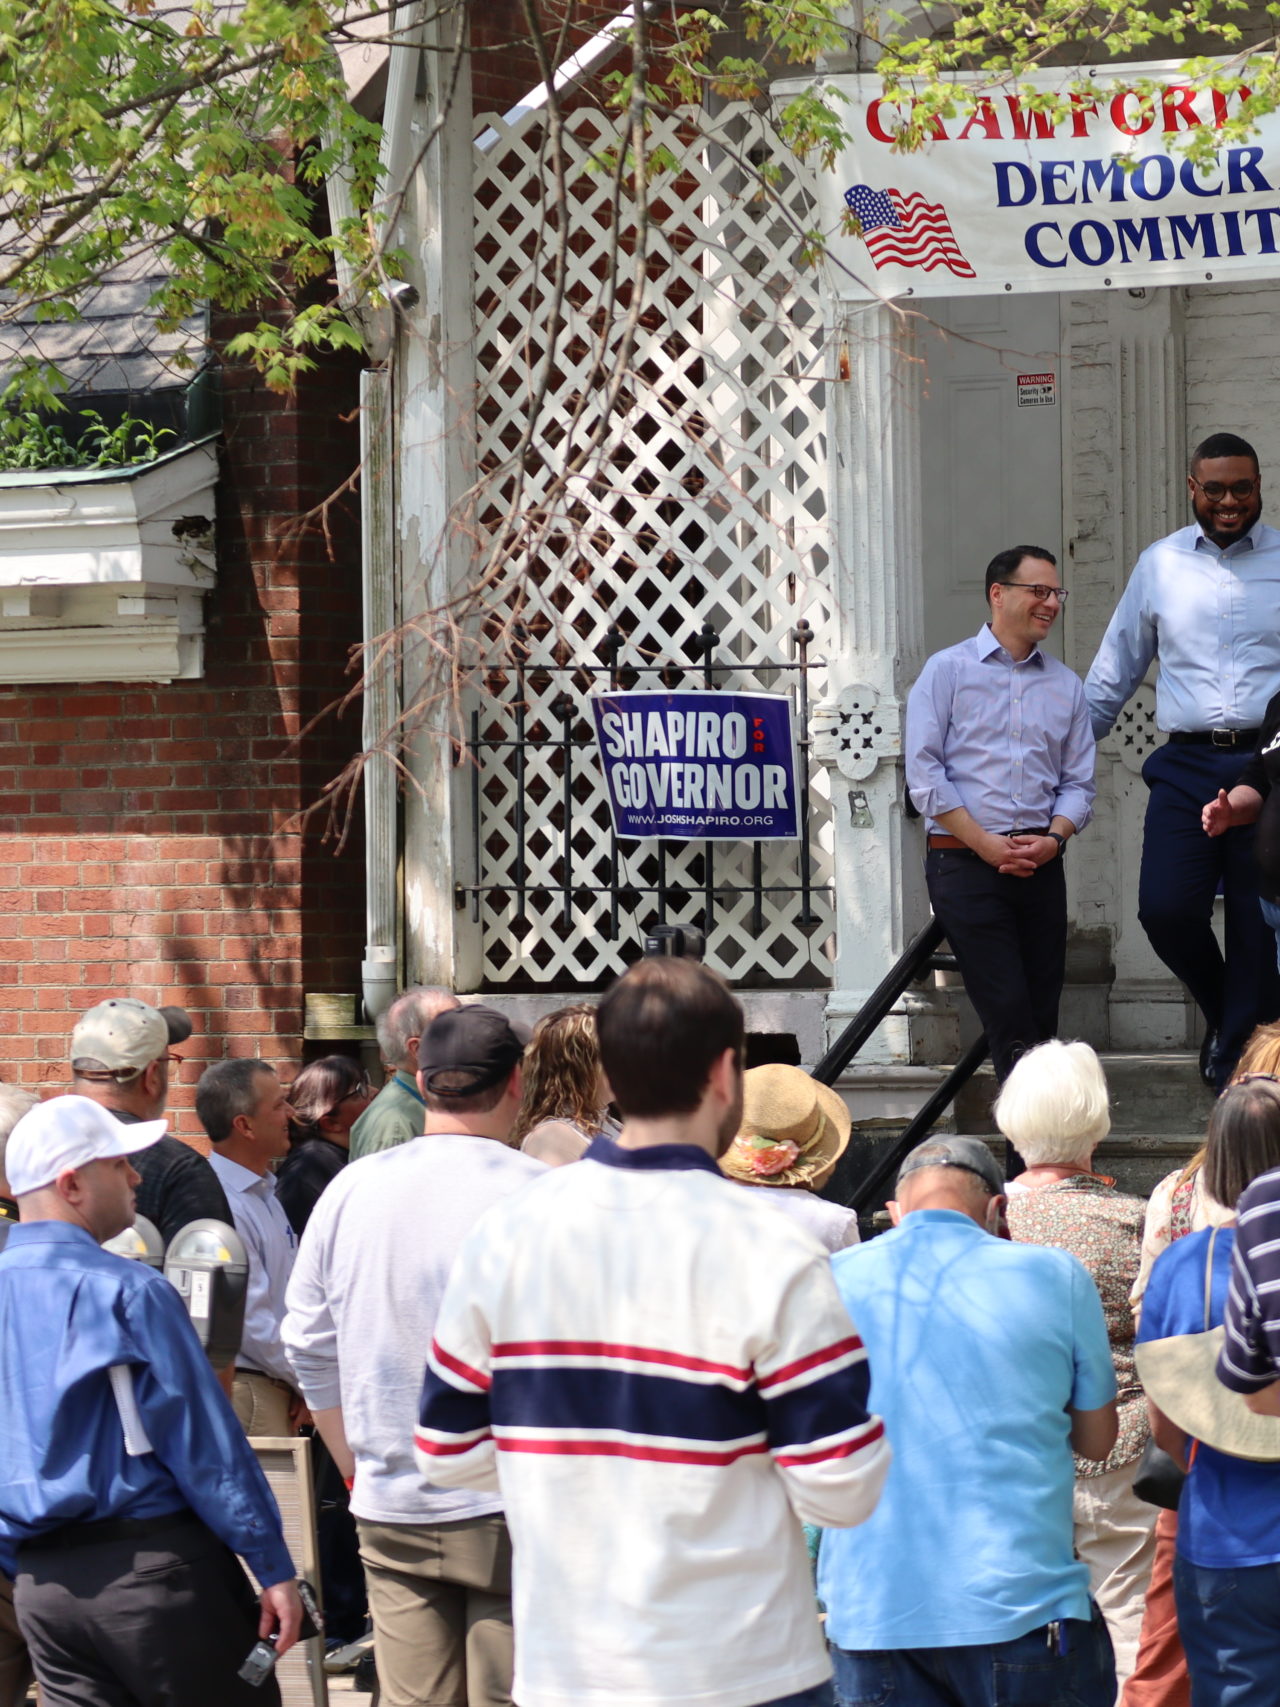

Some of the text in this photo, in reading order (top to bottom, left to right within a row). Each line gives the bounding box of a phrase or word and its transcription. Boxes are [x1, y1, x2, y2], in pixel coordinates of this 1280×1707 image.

[1019, 375, 1053, 384] WARNING
[602, 711, 747, 760] SHAPIRO
[753, 718, 765, 752] FOR
[611, 762, 789, 810] GOVERNOR
[628, 814, 774, 826] WWW.JOSHSHAPIRO.ORG
